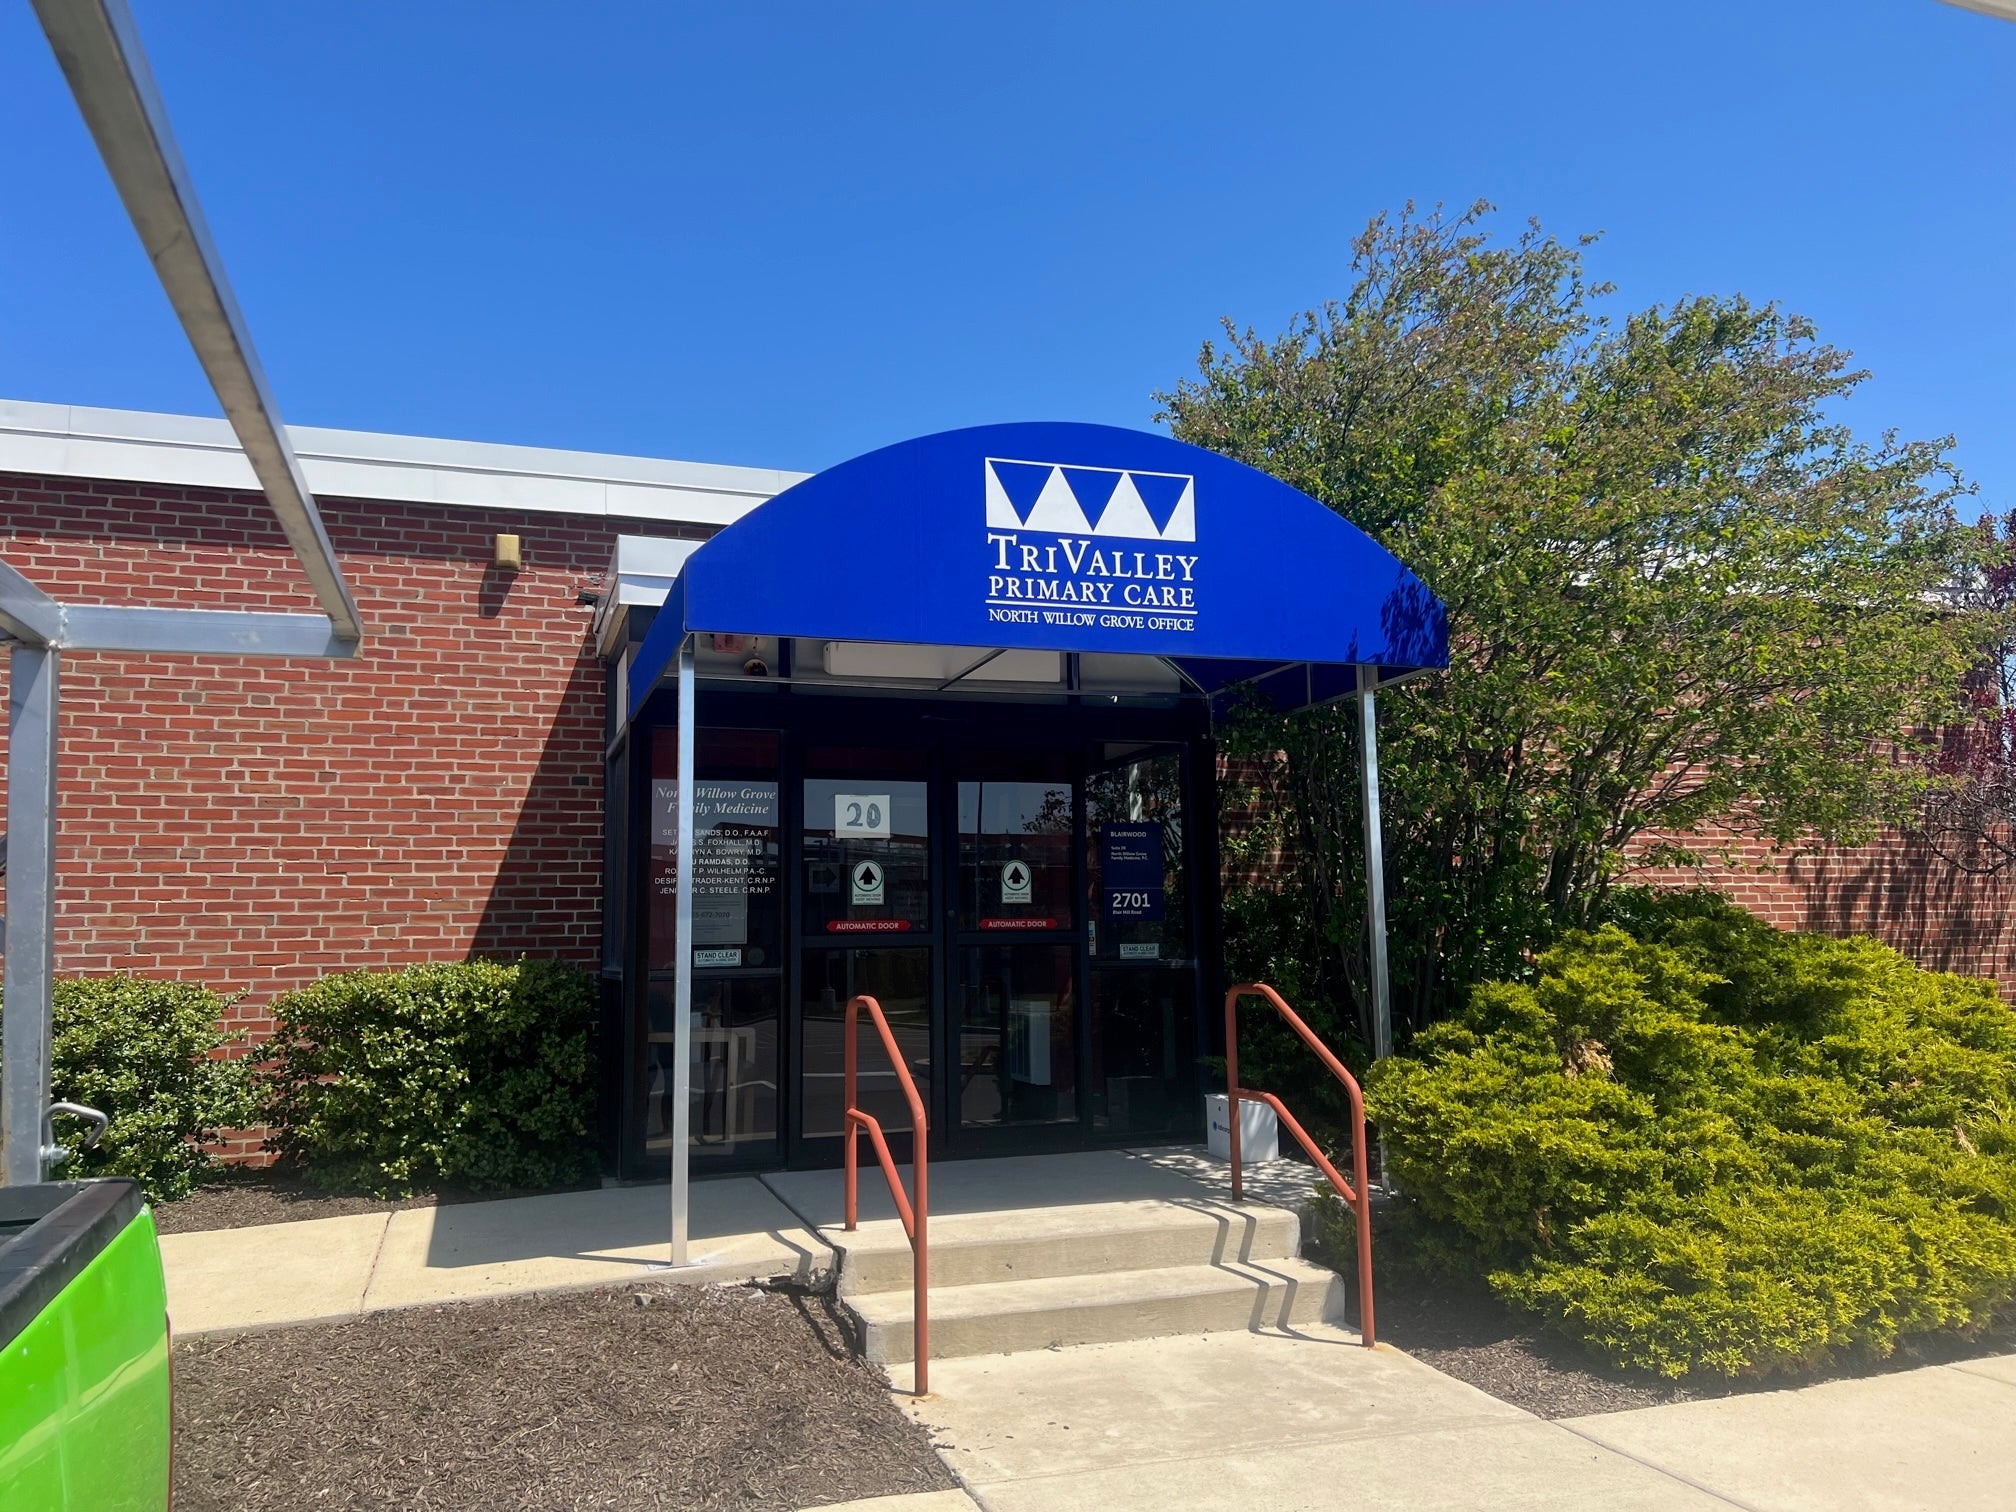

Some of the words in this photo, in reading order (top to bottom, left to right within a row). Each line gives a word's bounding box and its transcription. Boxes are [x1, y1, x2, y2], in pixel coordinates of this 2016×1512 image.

[988, 575, 1114, 603] PRIMARY
[1123, 584, 1195, 608] CARE
[988, 608, 1039, 624] NORTH
[1042, 611, 1096, 627] WILLOW
[1100, 614, 1145, 629] GROVE
[1148, 617, 1195, 632] OFFICE
[696, 787, 737, 799] Willow
[740, 788, 777, 800] Grove
[667, 802, 710, 816] Fily
[713, 802, 769, 815] Medicine
[846, 802, 882, 829] 20
[1112, 893, 1151, 908] 2701
[836, 922, 876, 931] AUTOMATIC
[878, 922, 899, 930] DOOR
[988, 920, 1025, 928] AUTOMATIC
[1026, 920, 1047, 928] DOOR
[718, 951, 738, 959] CLEAR
